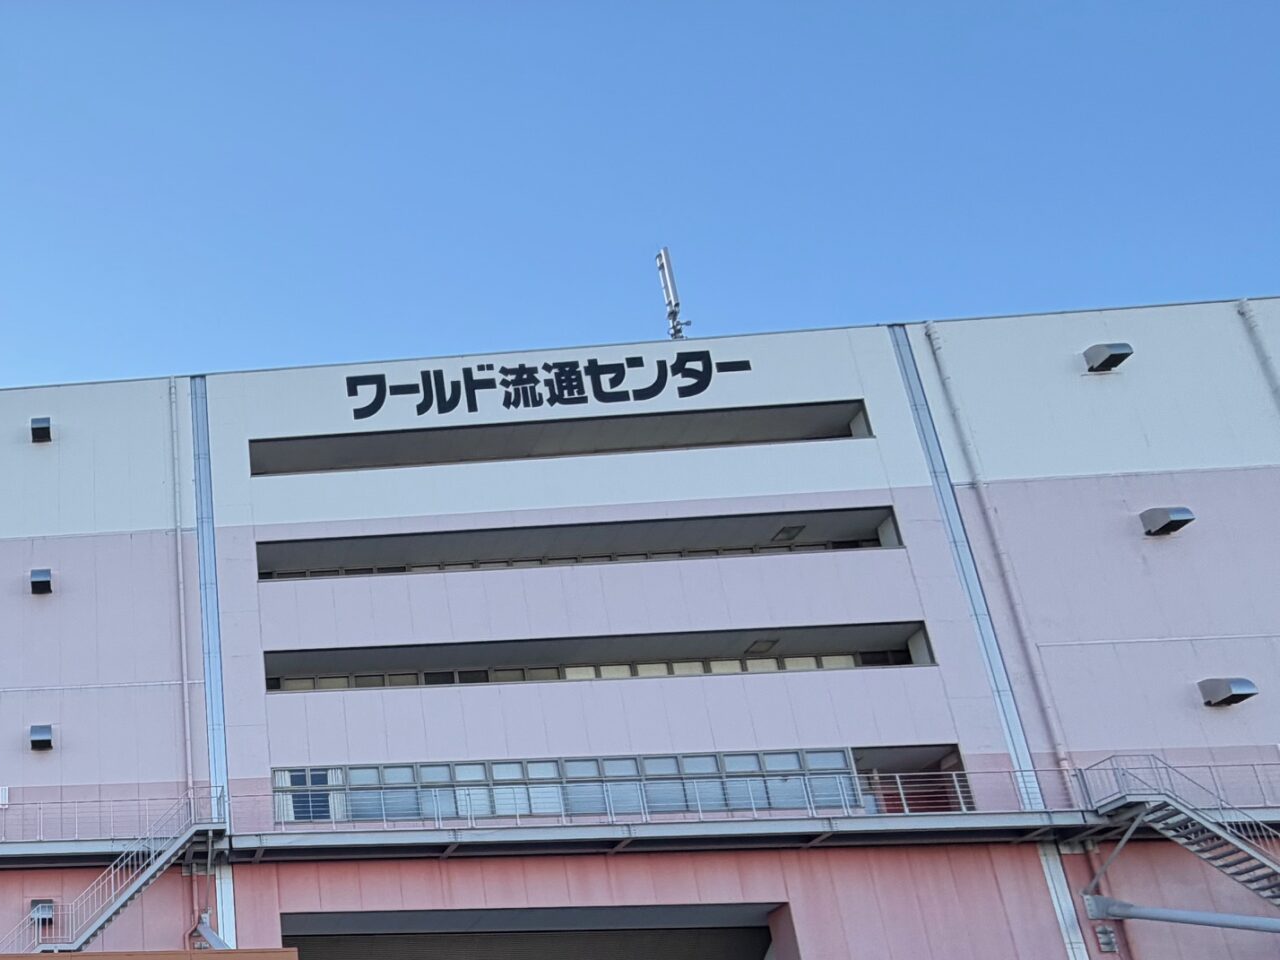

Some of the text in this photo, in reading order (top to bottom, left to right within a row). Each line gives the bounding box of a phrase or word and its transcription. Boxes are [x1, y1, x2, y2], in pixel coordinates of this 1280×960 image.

[345, 350, 751, 420] ワールド流通センター
